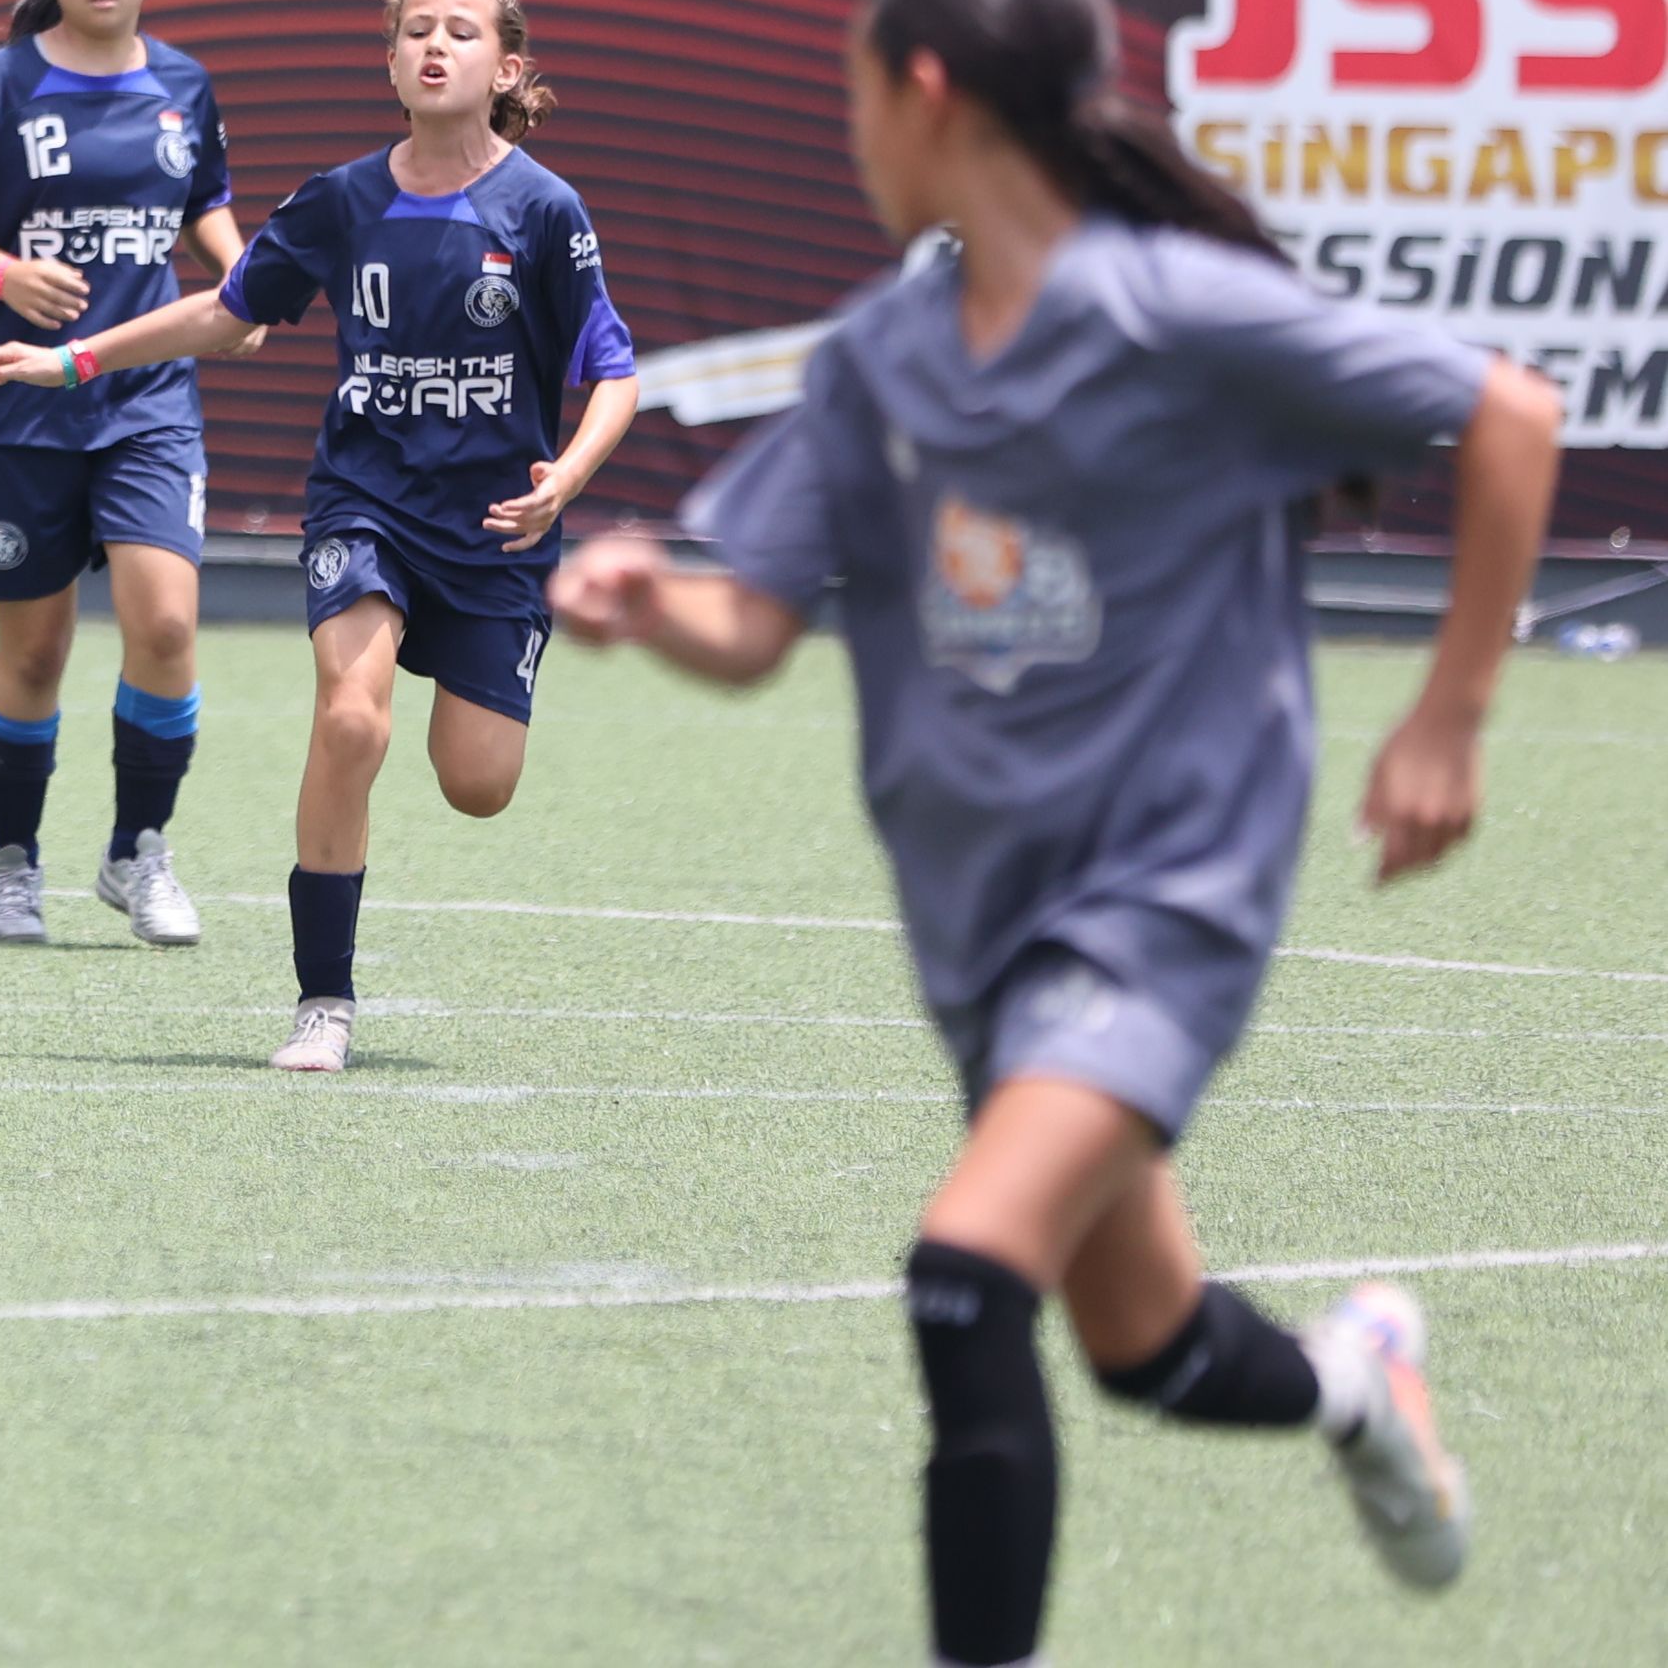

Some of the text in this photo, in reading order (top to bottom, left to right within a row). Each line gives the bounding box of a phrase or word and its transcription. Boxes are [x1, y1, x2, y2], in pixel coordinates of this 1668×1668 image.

[17, 113, 72, 180] 12
[149, 208, 184, 229] THE
[354, 353, 514, 377] NLEASH THE
